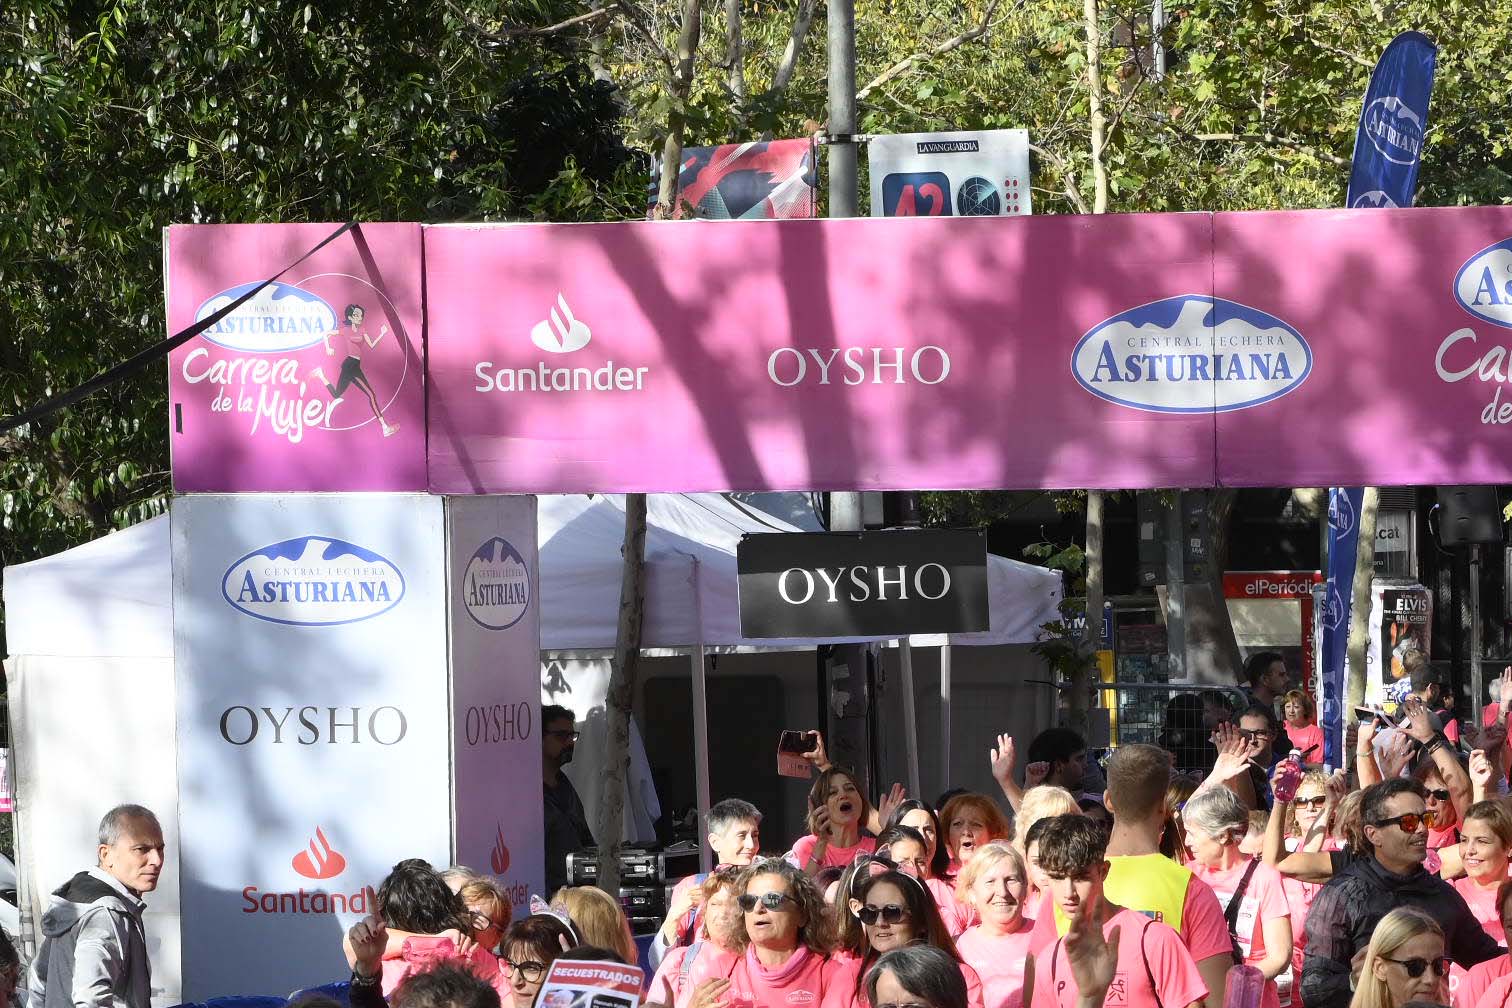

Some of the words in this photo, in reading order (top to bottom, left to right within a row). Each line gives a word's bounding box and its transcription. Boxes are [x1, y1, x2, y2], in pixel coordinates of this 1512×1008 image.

[918, 144, 929, 153] LA
[929, 141, 978, 152] VANGUARDIA
[1127, 335, 1201, 349] CENTRAL
[1210, 334, 1286, 348] LECHERA
[182, 347, 300, 385] Carrera
[476, 361, 649, 392] Santander
[767, 345, 951, 386] OYSHO
[1090, 339, 1294, 383] ASTURIANA
[211, 387, 233, 412] de
[237, 387, 253, 412] la
[250, 382, 345, 443] Mujer
[237, 570, 392, 604] ASTURIANA
[264, 567, 323, 577] CENTRAL
[778, 562, 951, 606] OYSHO
[1245, 578, 1317, 596] elPeriódi
[468, 572, 527, 608] ASTURIANA
[1396, 598, 1427, 611] ELVIS
[219, 705, 408, 747] OYSHO
[465, 701, 533, 746] OYSHO
[242, 886, 368, 915] Santand
[552, 967, 641, 986] SECUESTRADOS
